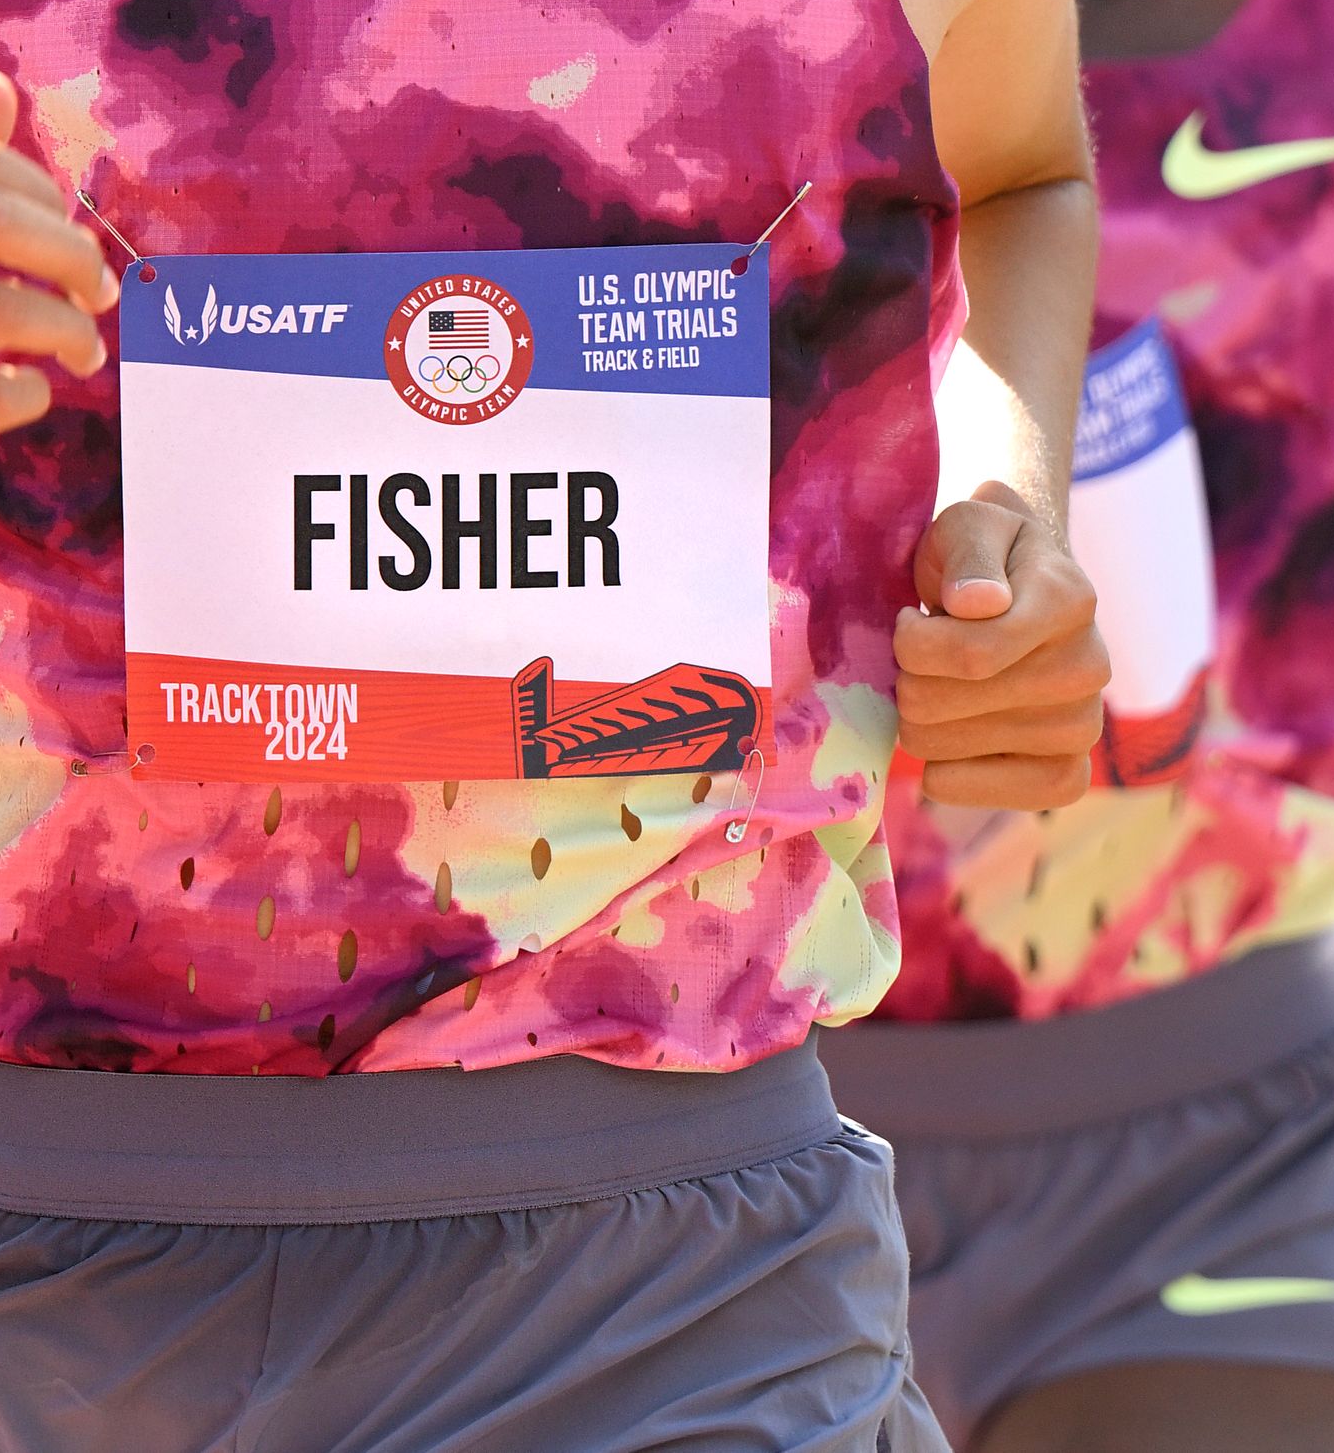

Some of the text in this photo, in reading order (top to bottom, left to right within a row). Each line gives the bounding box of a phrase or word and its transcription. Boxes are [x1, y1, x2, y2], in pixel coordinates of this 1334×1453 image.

[400, 279, 516, 318] UNITED STATES
[578, 269, 736, 306] U.S. OLYMPIC
[220, 304, 348, 334] USATF
[578, 306, 737, 344] TEAM TRIALS
[582, 346, 700, 372] TRACK & FIELD
[403, 384, 515, 421] OLYMPIC TEAM
[293, 471, 622, 592] FISHER
[160, 682, 358, 724] TRACKTOWN
[265, 720, 348, 761] 2024
